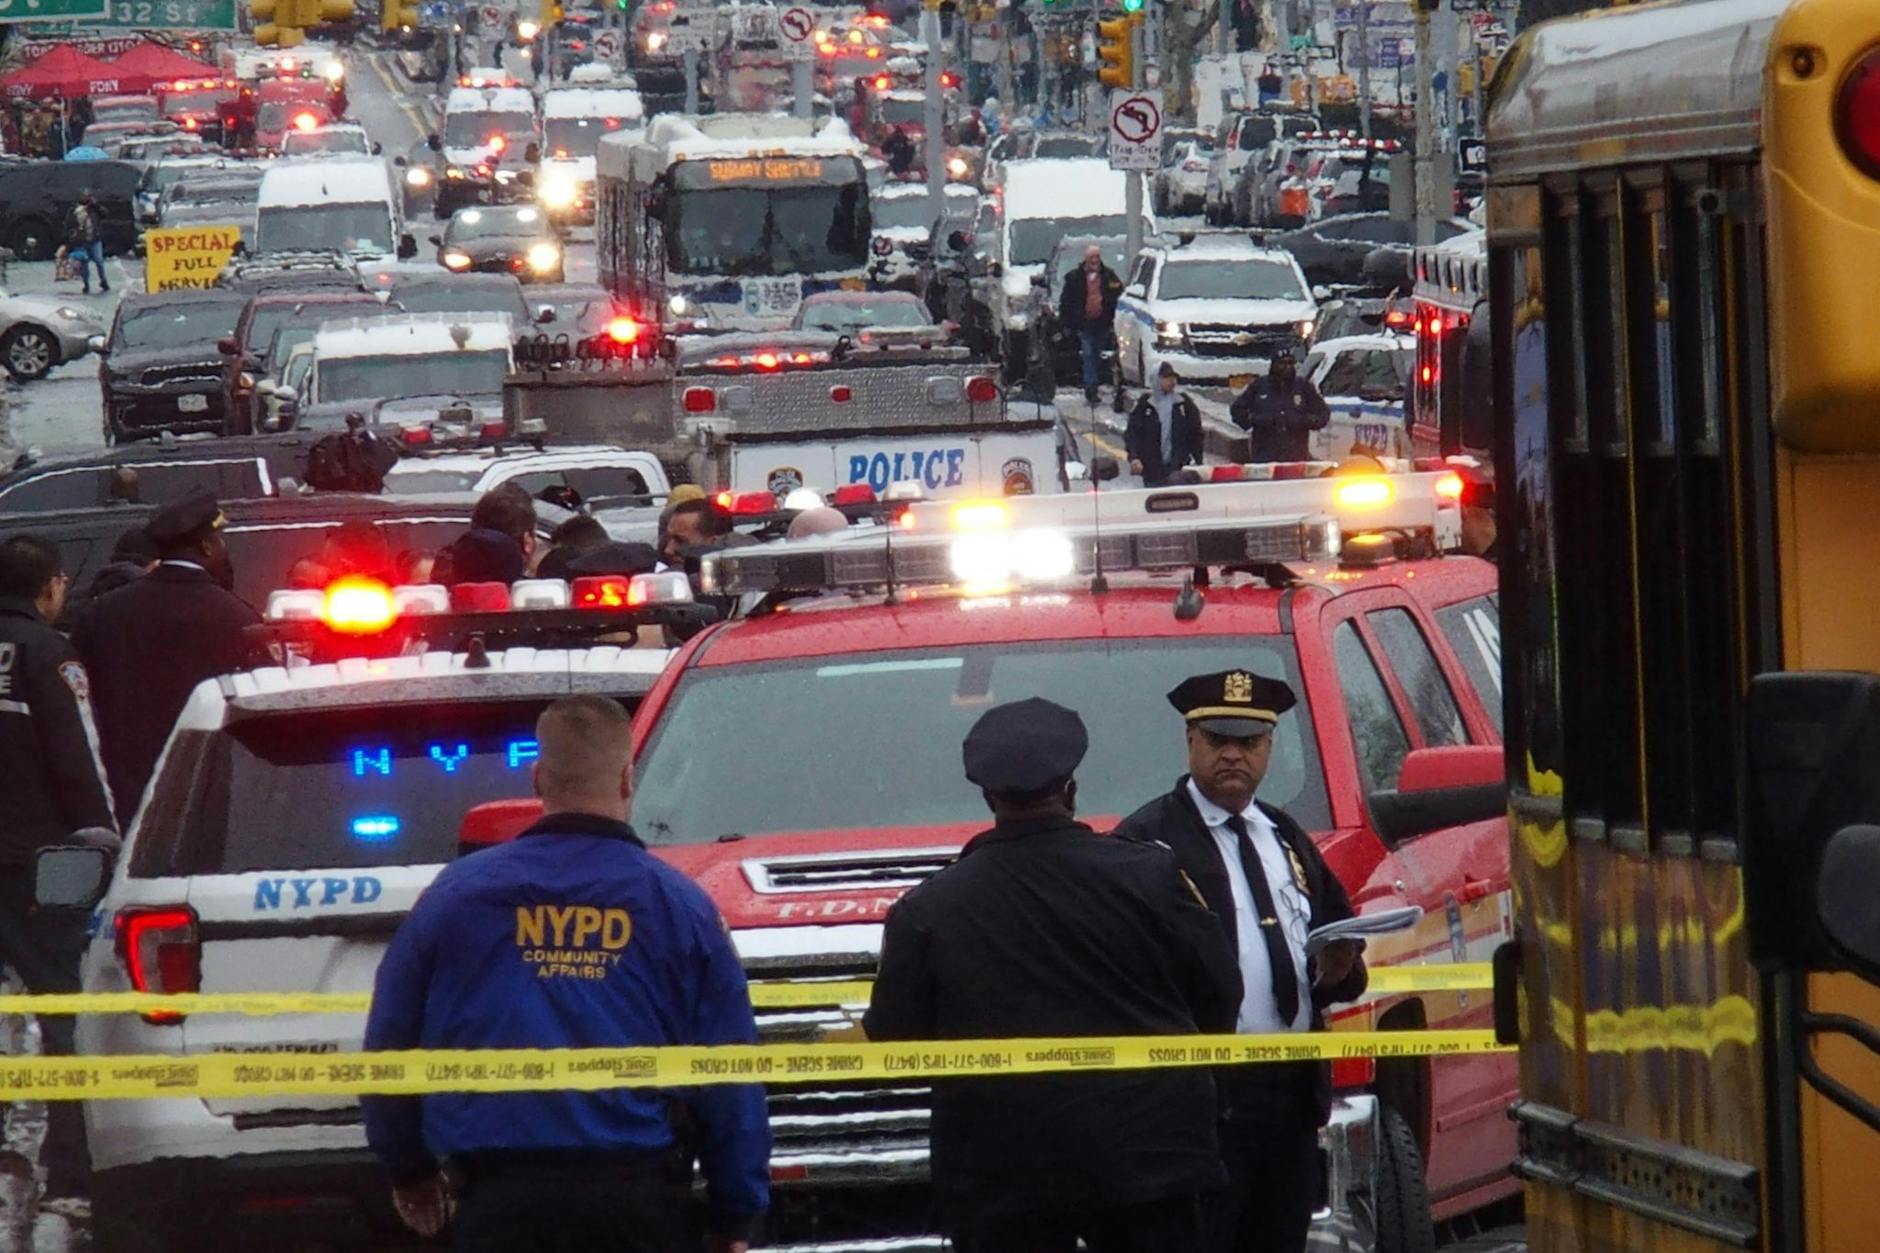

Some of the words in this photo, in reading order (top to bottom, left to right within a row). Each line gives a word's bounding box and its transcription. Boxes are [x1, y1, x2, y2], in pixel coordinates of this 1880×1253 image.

[117, 3, 151, 22] 32
[165, 5, 197, 22] St
[152, 233, 233, 253] SPECIAL
[172, 256, 217, 271] FULL
[849, 448, 964, 493] POLICE
[253, 876, 382, 910] NYPD
[516, 904, 632, 949] NYPD
[521, 949, 622, 966] COMMUNITY
[537, 963, 606, 979] AFFAIRS
[884, 1053, 920, 1071] (8477)
[923, 1052, 1012, 1068] 1-800-577-TIPS
[1149, 1048, 1186, 1063] CROSS
[1191, 1047, 1211, 1062] NOT
[1215, 1047, 1231, 1062] DO
[730, 1057, 753, 1073] NOT
[756, 1057, 773, 1073] DO
[787, 1055, 823, 1073] SCENE
[827, 1055, 863, 1071] CRIME
